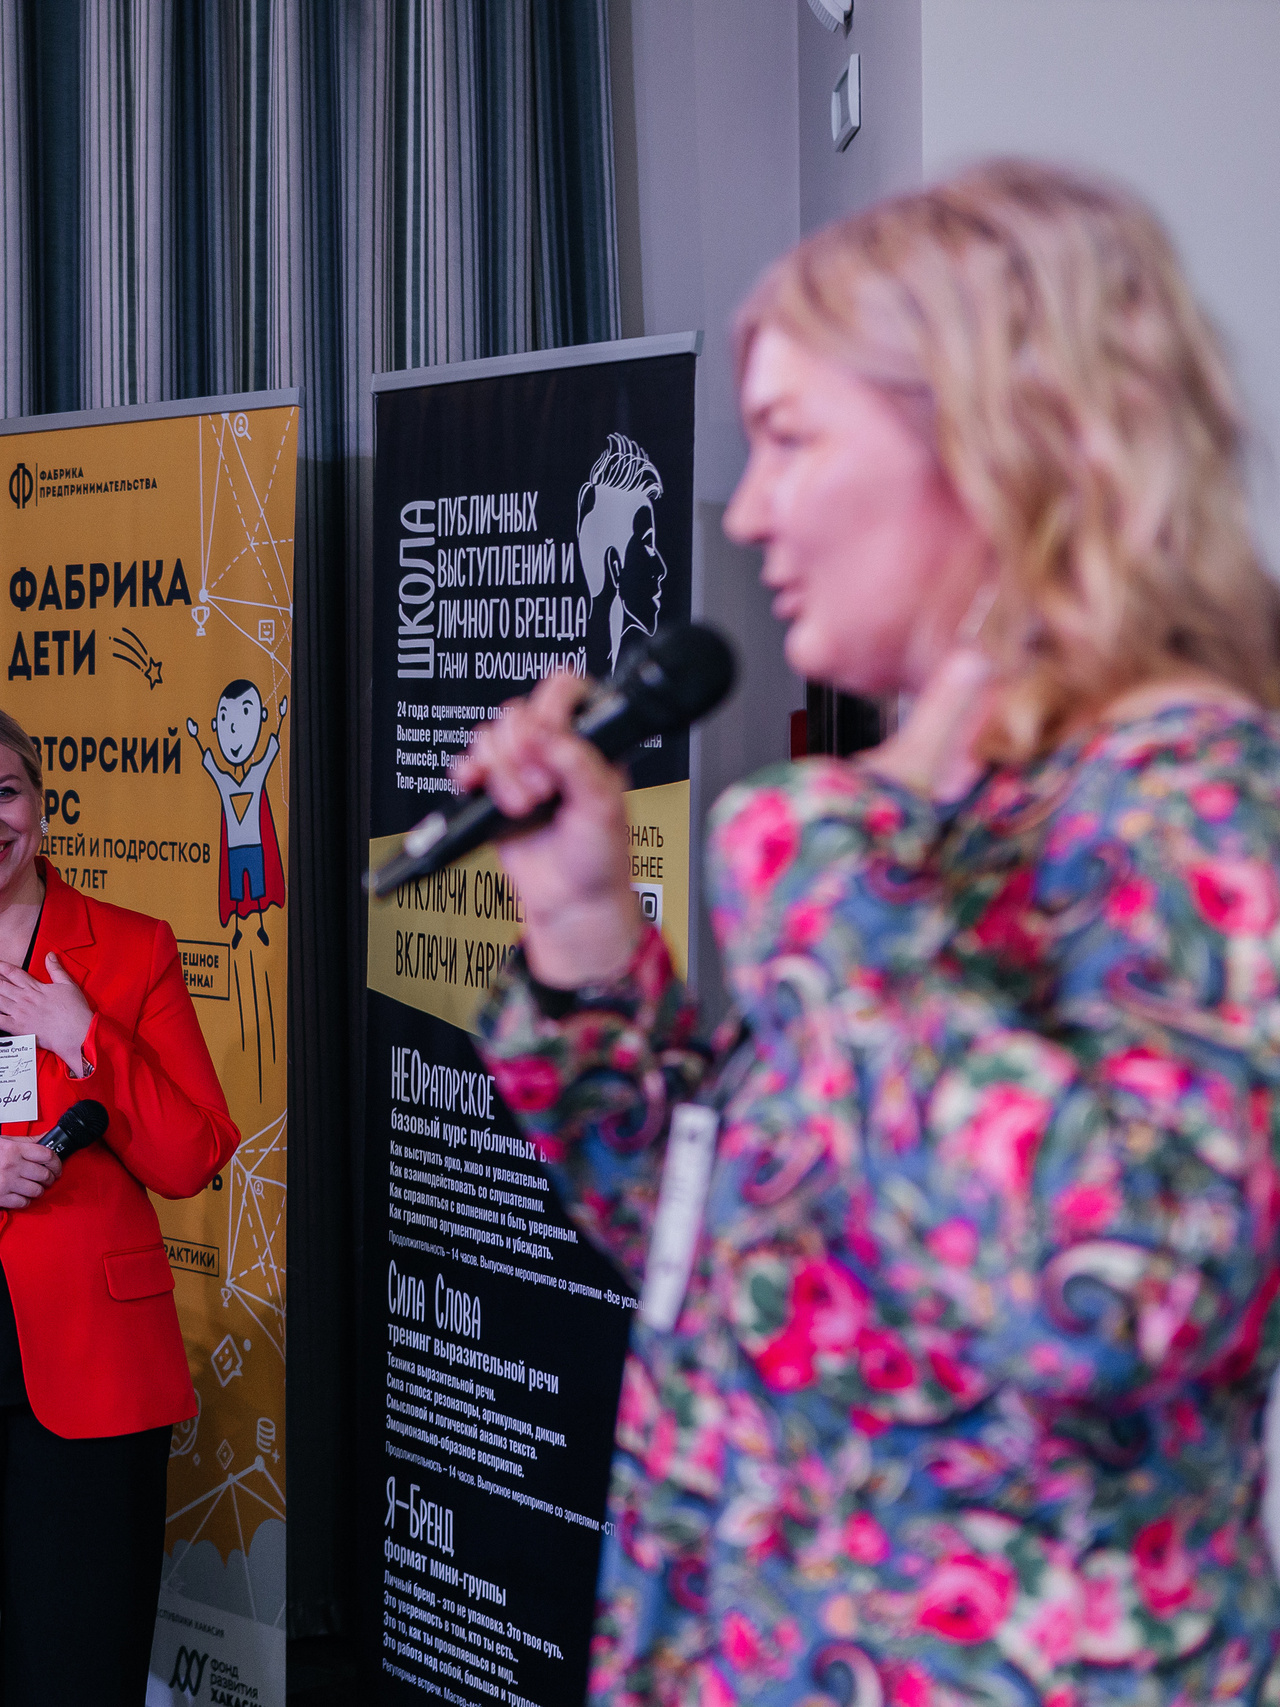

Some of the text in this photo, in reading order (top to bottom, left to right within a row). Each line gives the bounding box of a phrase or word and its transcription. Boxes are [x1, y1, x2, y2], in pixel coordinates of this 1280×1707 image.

[40, 467, 84, 480] ФАБРИКА
[40, 478, 158, 498] ПРЕДПРИНИМАТЕЛЬСТВА
[437, 490, 538, 537] ПУБЛИЧНЫХ
[9, 558, 192, 611] ФАБРИКА
[437, 538, 574, 587] ВЫСТУПЛЕНИЙ И
[397, 500, 436, 679] ШКОЛА
[436, 596, 586, 641] ЛИЧНОГО БРЕНДА
[8, 629, 96, 681] ДЕТИ
[437, 651, 468, 679] ТАНИ
[396, 724, 431, 742] Высшее
[397, 700, 407, 718] 24
[408, 704, 429, 720] года
[431, 705, 485, 721] сценического
[30, 727, 181, 774] ВТОРСКИЙ
[396, 748, 439, 770] Режиссёр.
[44, 789, 81, 825] РС
[40, 833, 211, 864] ДЕТЕЙ И ПОДРОСТКОВ
[625, 825, 664, 848] ЗНАТЬ
[65, 867, 77, 887] 17
[80, 868, 107, 889] ЛЕТ
[475, 870, 526, 923] СОМНЕ
[178, 952, 219, 968] ЕШНОЕ
[184, 969, 213, 988] ЁНКА!
[396, 930, 457, 985] ВКЛЮЧИ
[391, 1107, 440, 1139] базовый
[443, 1122, 467, 1148] курс
[470, 1127, 537, 1163] публичных
[389, 1161, 545, 1213] Как взаимодействовать со слушателями.
[390, 1140, 550, 1192] Как выступать ярко, живо и увлекательно.
[389, 1182, 579, 1244] Как справляться с волнением и быть уверенным.
[389, 1202, 554, 1261] Как грамотно аргументировать и убеждать.
[165, 1245, 215, 1268] РАКТИКИ
[451, 1247, 459, 1261] 14
[460, 1252, 479, 1267] часов.
[480, 1255, 514, 1276] Выпускное
[515, 1267, 557, 1288] мероприятие
[558, 1278, 567, 1290] со
[568, 1281, 602, 1300] зрителями
[387, 1351, 496, 1402] Техника выразительной речи.
[388, 1323, 559, 1394] тренинг выразительной речи
[386, 1393, 538, 1460] Смысловой и логический анализ текста.
[387, 1372, 567, 1447] Сила голоса: резонаторы, артикуляция, дикция.
[386, 1414, 525, 1478] Эмоционально-образное восприятие.
[449, 1465, 456, 1479] 14
[457, 1470, 476, 1487] часов.
[477, 1474, 511, 1499] Выпускное
[512, 1491, 554, 1515] мероприятие
[554, 1506, 563, 1518] со
[564, 1510, 600, 1532] зрителями
[384, 1536, 507, 1607] формат мини-группы
[383, 1590, 397, 1609] Это
[398, 1599, 443, 1630] уверенность
[444, 1619, 450, 1632] в
[451, 1622, 467, 1643] том,
[468, 1630, 482, 1647] кто
[483, 1636, 495, 1652] ты
[384, 1569, 564, 1660] Личный бренд это не упаковка. Это твоя суть.
[383, 1611, 397, 1630] Это
[398, 1620, 408, 1637] то,
[409, 1624, 421, 1642] как
[422, 1631, 434, 1647] ты
[434, 1638, 489, 1672] проявляешься
[490, 1663, 496, 1675] в
[383, 1631, 396, 1650] Это
[397, 1640, 423, 1663] работа
[424, 1652, 438, 1672] над
[439, 1659, 464, 1685] собой,
[464, 1670, 500, 1698] большая
[501, 1688, 506, 1701] и
